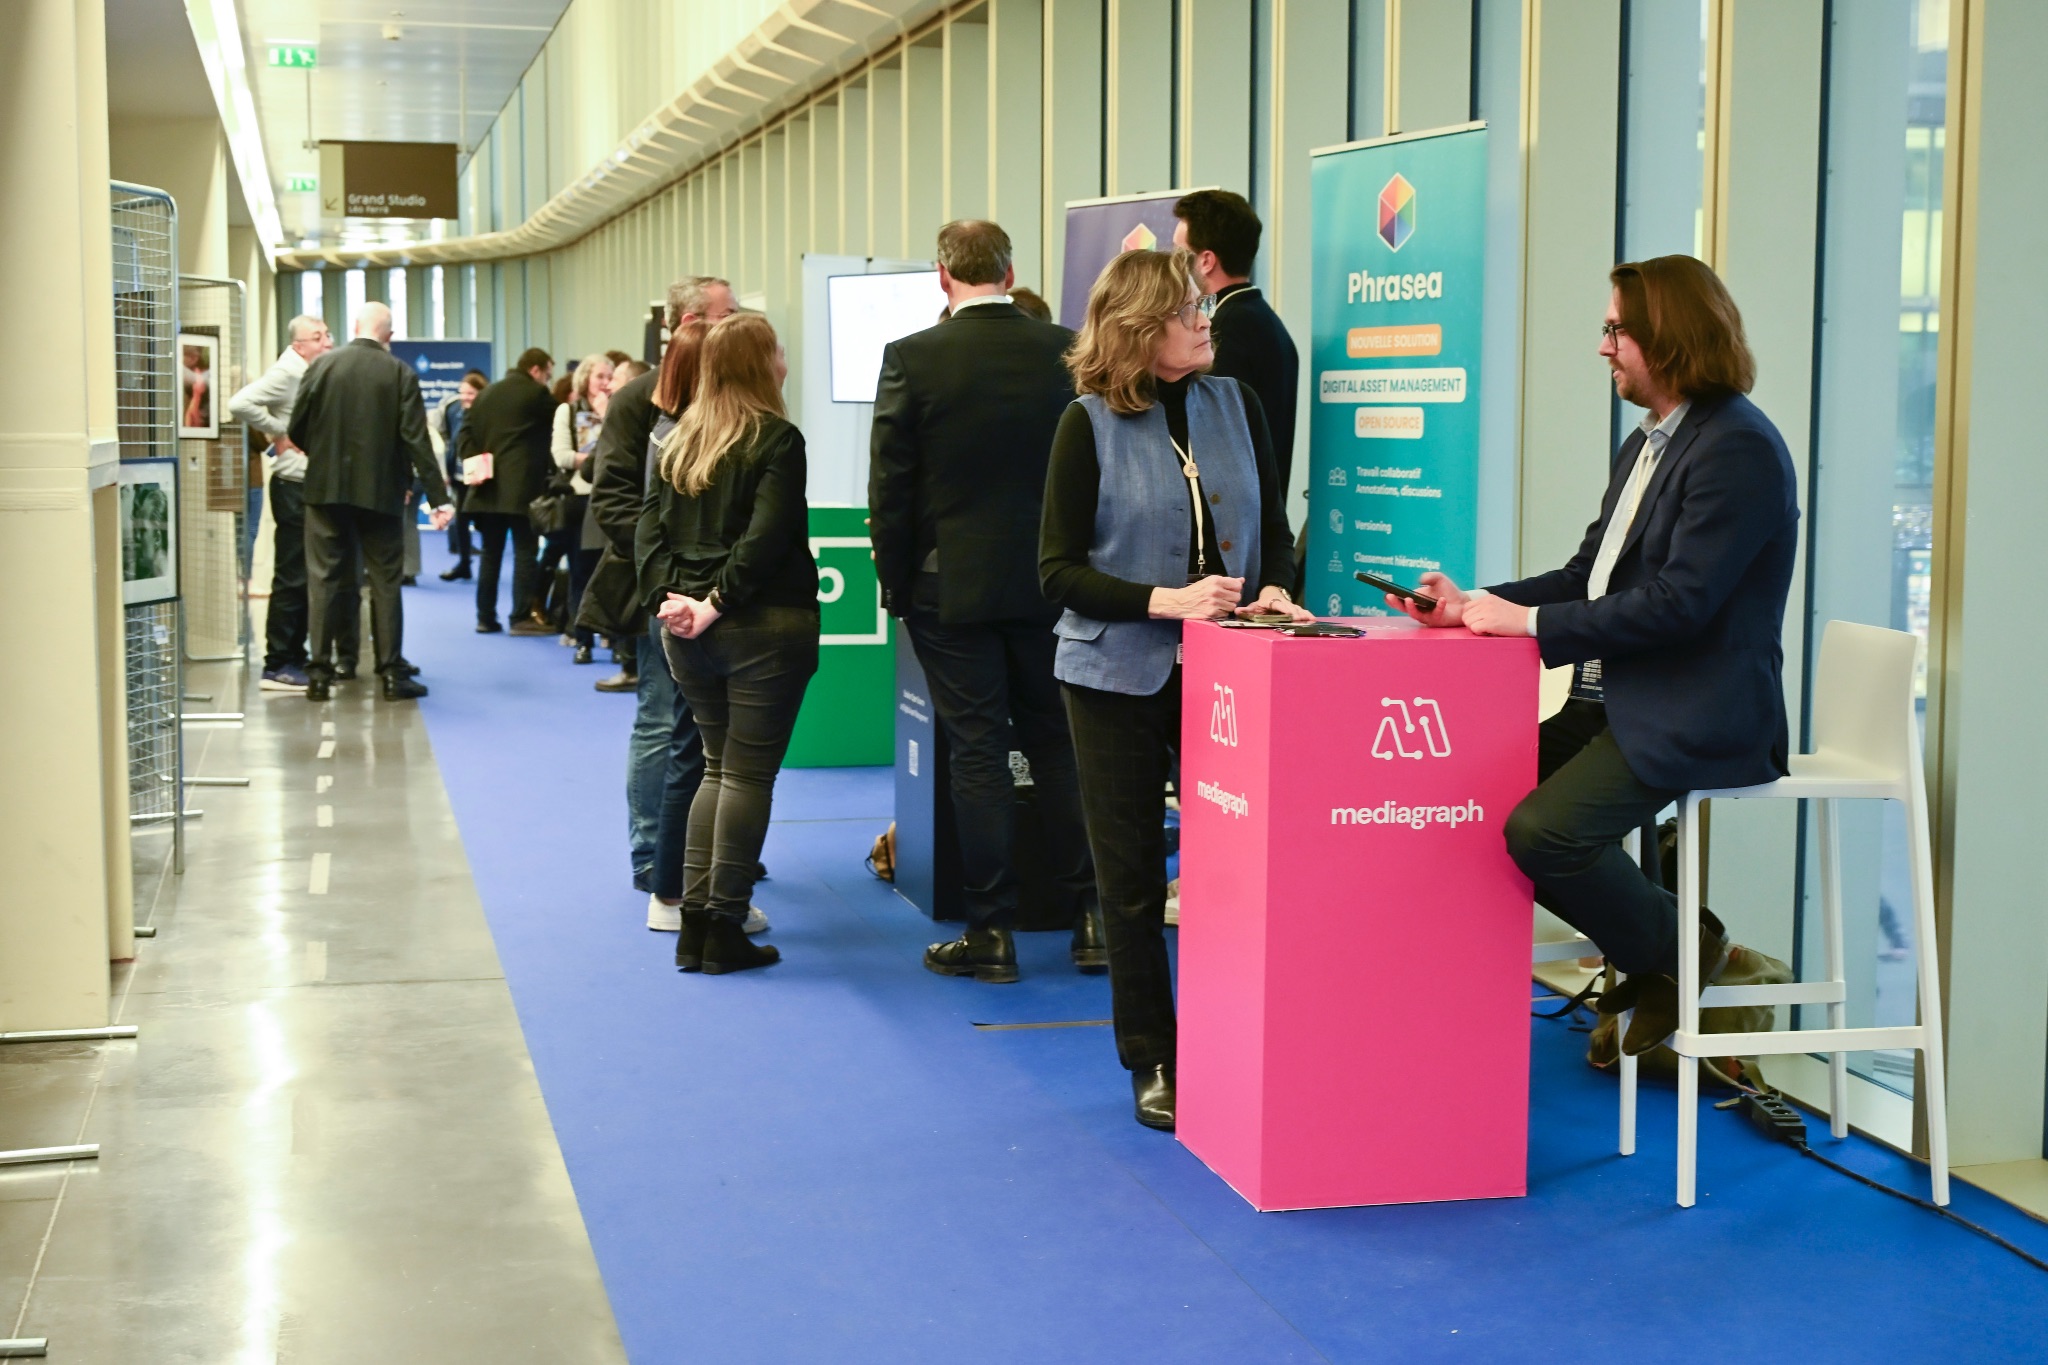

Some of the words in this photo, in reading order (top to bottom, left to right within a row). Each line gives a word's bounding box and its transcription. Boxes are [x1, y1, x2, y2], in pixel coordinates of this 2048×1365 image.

[348, 193, 385, 205] Grand
[388, 194, 426, 206] Studio
[1347, 269, 1443, 304] Phrasea
[1350, 335, 1392, 350] NOUVELLE
[1394, 333, 1438, 348] SOLUTION
[1323, 380, 1358, 393] DIGITAL
[1359, 379, 1388, 393] ASSET
[1389, 378, 1461, 393] MANAGEMENT
[1358, 416, 1381, 429] OPEN
[1383, 416, 1421, 430] SOURCE
[1356, 466, 1379, 477] Travail
[1380, 467, 1422, 479] collaboratif
[1400, 485, 1442, 498] discussions
[1355, 520, 1392, 534] Versioning
[1353, 552, 1394, 566] Classement
[1352, 604, 1388, 617] Workflow
[1197, 780, 1249, 819] mediagraph
[1331, 799, 1484, 829] mediagraph
